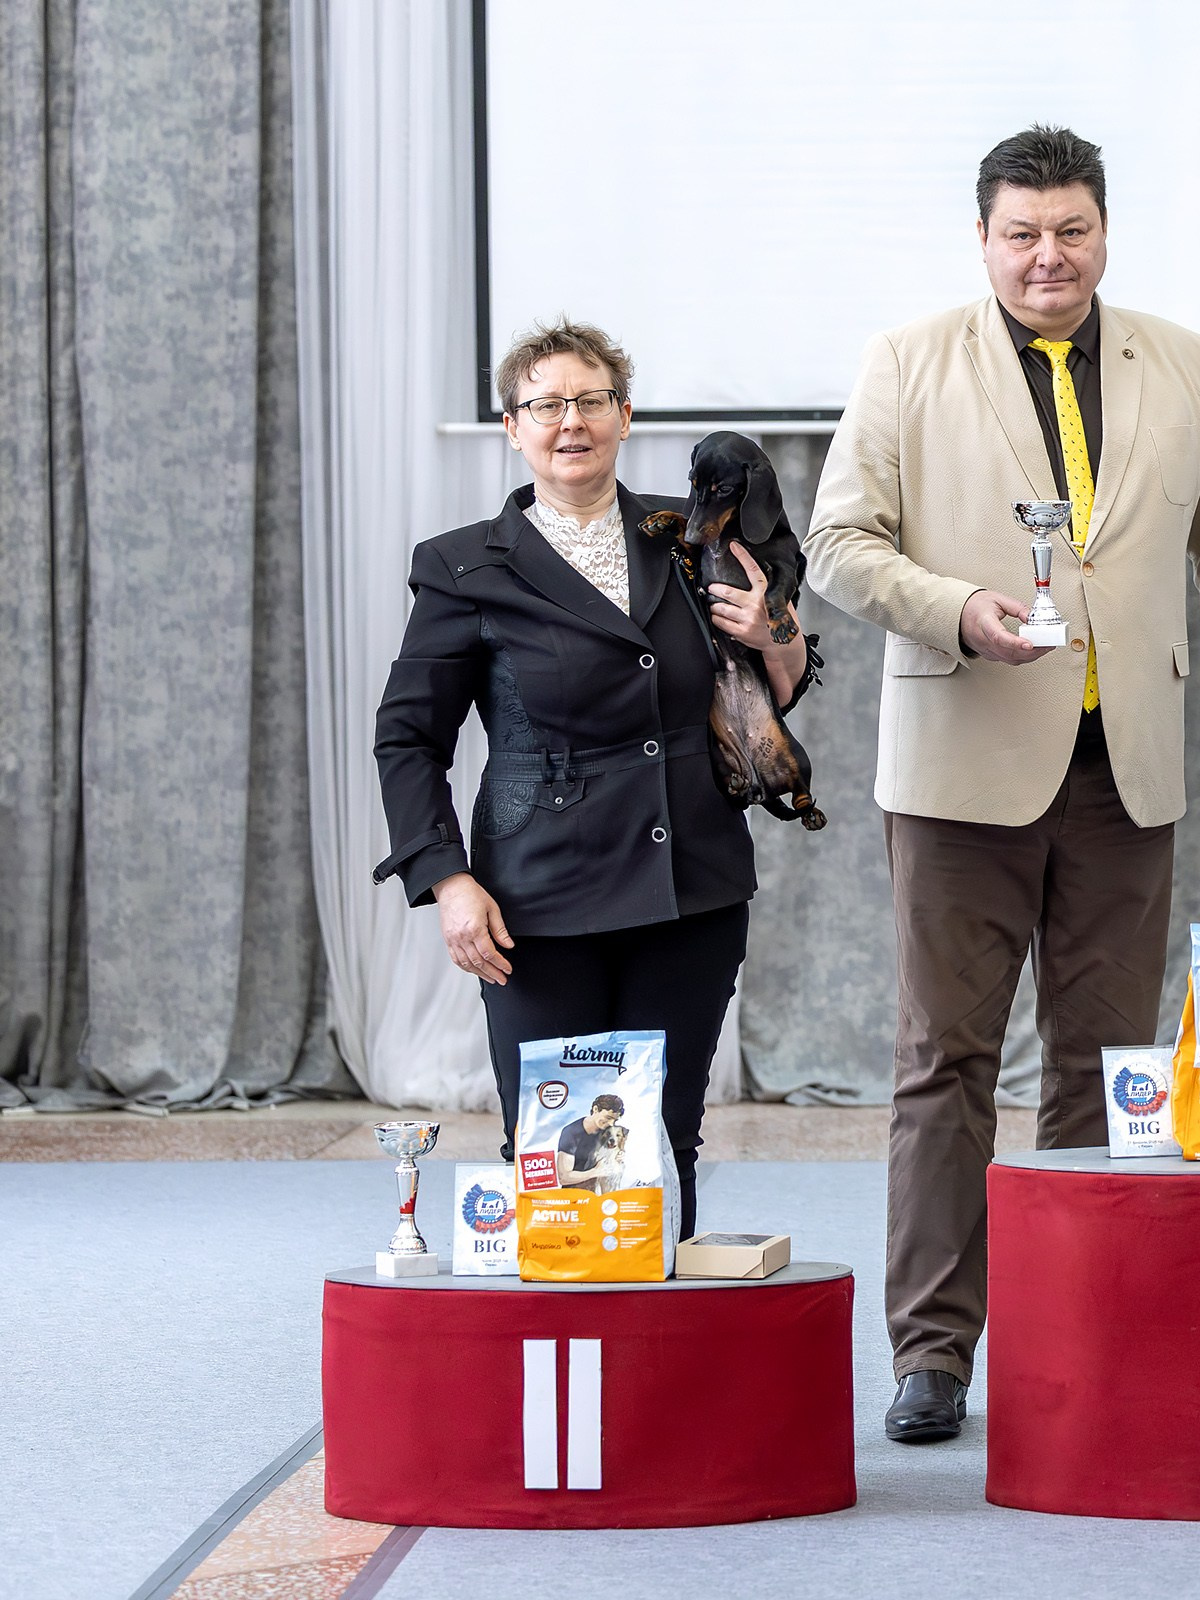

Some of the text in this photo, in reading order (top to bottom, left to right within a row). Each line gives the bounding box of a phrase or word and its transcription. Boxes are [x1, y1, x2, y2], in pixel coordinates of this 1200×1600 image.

[561, 1043, 626, 1072] Karmy
[1128, 1120, 1160, 1135] BIG
[532, 1209, 579, 1222] ACTIVE
[474, 1239, 506, 1253] BIG
